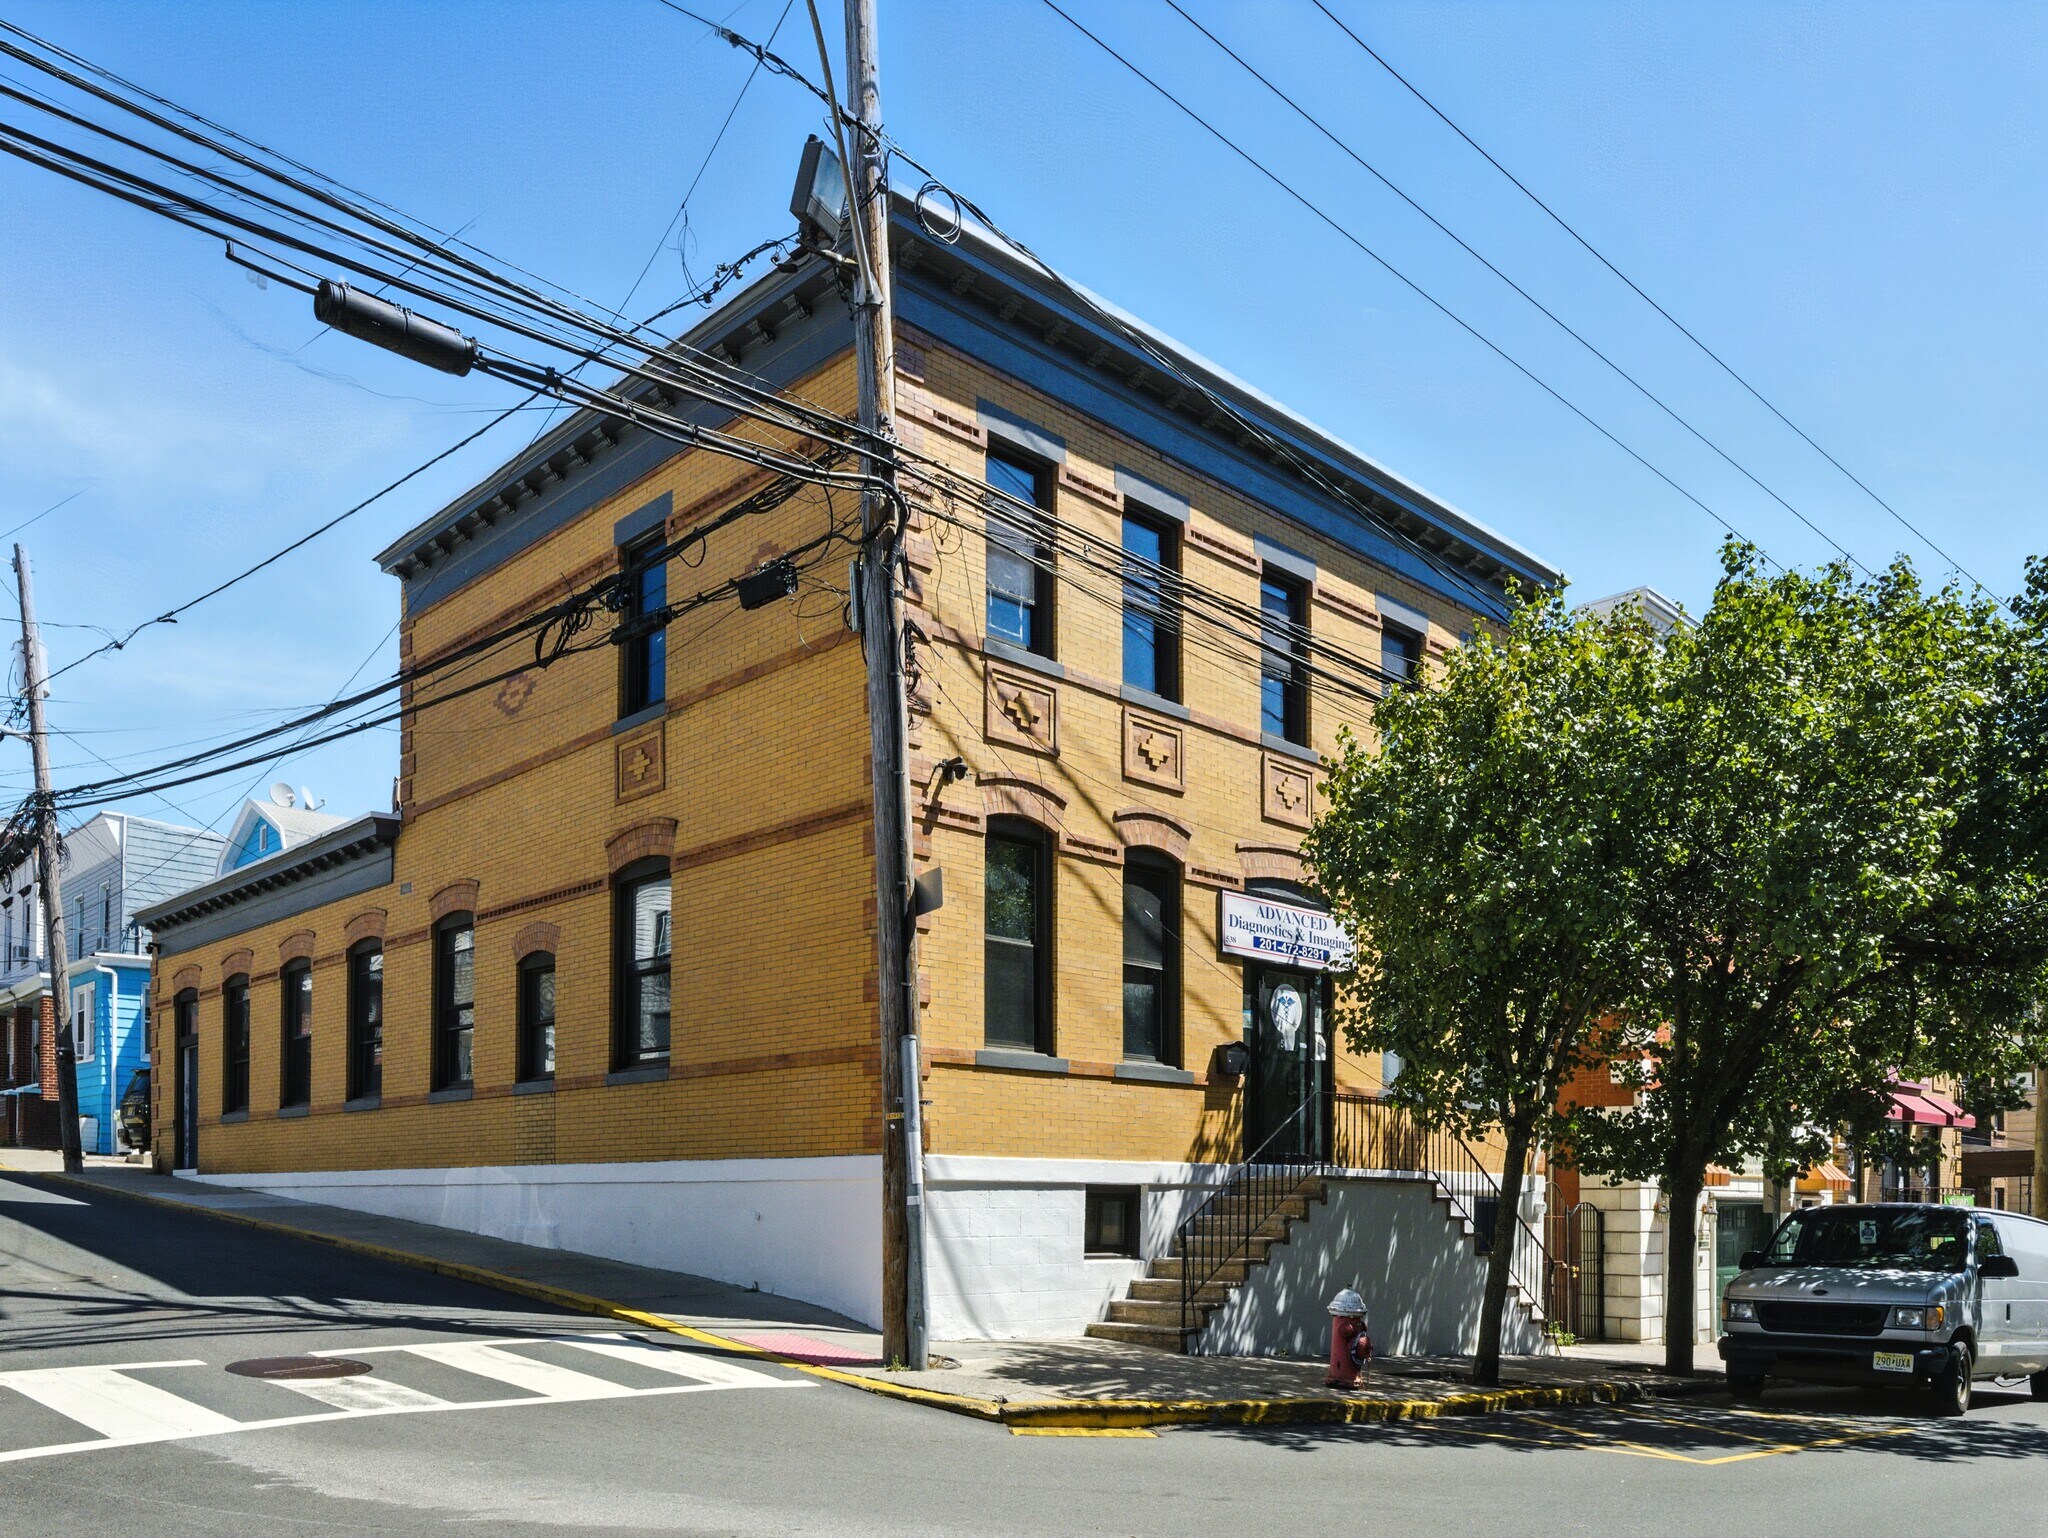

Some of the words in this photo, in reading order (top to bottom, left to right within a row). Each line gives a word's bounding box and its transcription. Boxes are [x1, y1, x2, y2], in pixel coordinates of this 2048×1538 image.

[1256, 905, 1328, 932] ADVANCED
[1229, 913, 1293, 940] Diagnostics
[1309, 930, 1351, 954] Imaging
[1259, 938, 1325, 960] 201-472-8291
